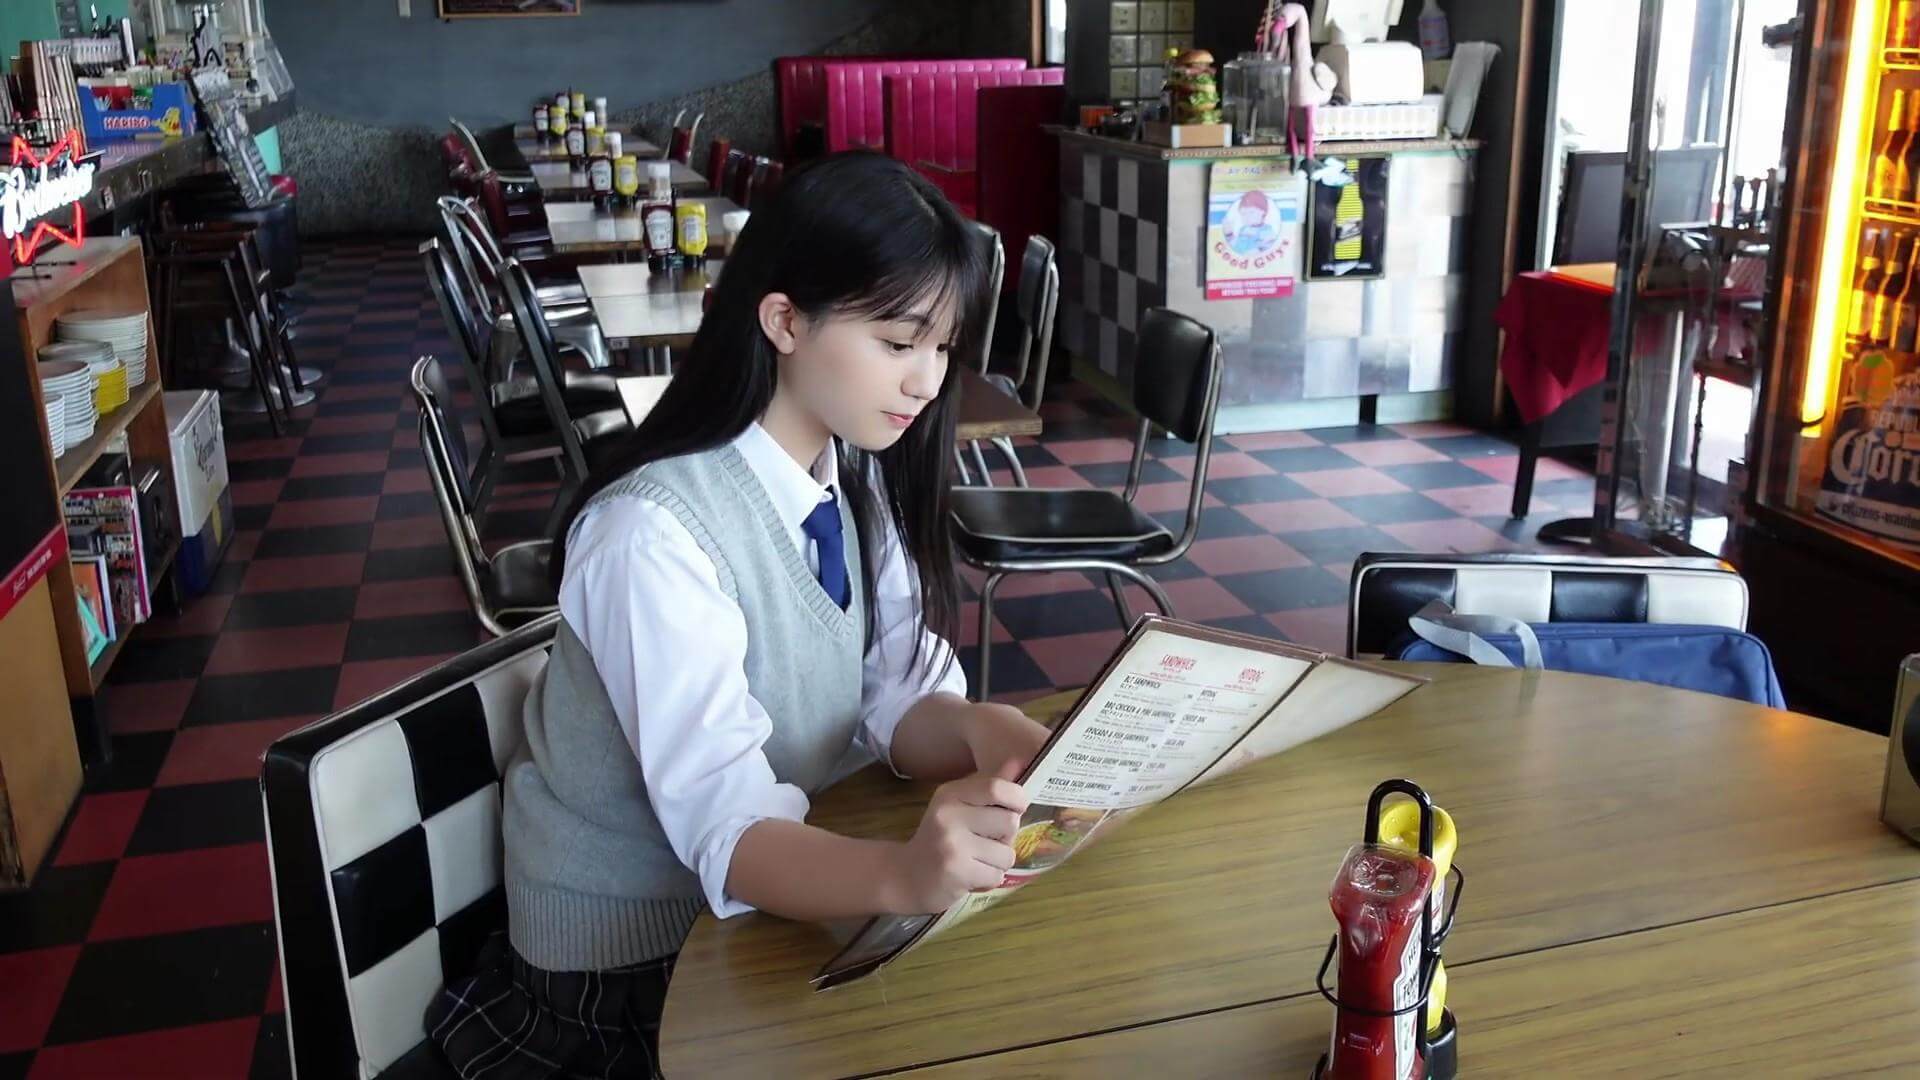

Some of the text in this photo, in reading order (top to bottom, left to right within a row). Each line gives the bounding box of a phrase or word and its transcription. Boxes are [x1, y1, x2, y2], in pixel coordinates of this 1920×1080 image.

[104, 116, 150, 130] HARIBO
[1214, 239, 1290, 269] Good Guys
